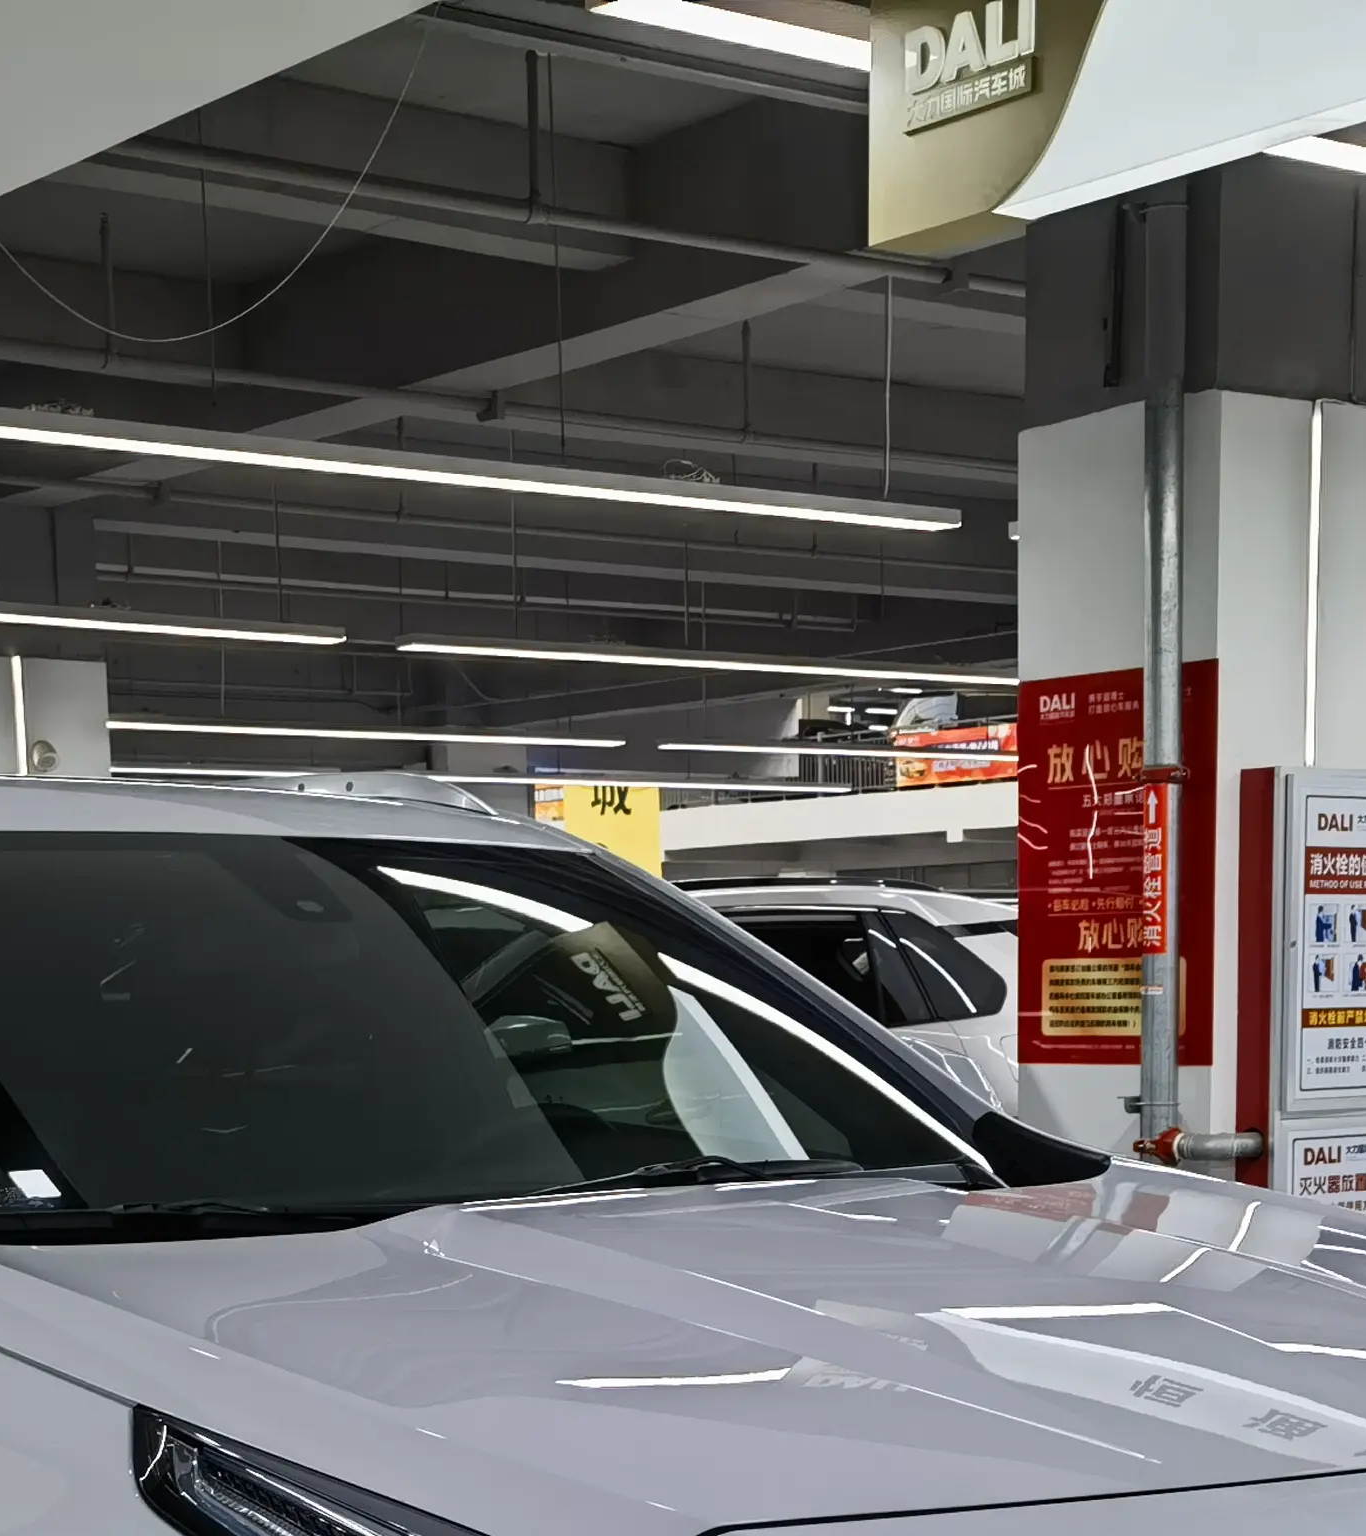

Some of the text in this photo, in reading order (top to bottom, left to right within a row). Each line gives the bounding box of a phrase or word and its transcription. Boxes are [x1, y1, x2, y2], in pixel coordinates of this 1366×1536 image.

[905, 0, 1035, 94] DALI
[1039, 692, 1075, 713] DALI
[1317, 813, 1353, 831] DALI
[1143, 827, 1162, 947] 消火栓管道
[1339, 880, 1348, 889] OF
[1349, 880, 1363, 889] USE
[1304, 1145, 1341, 1166] DALI
